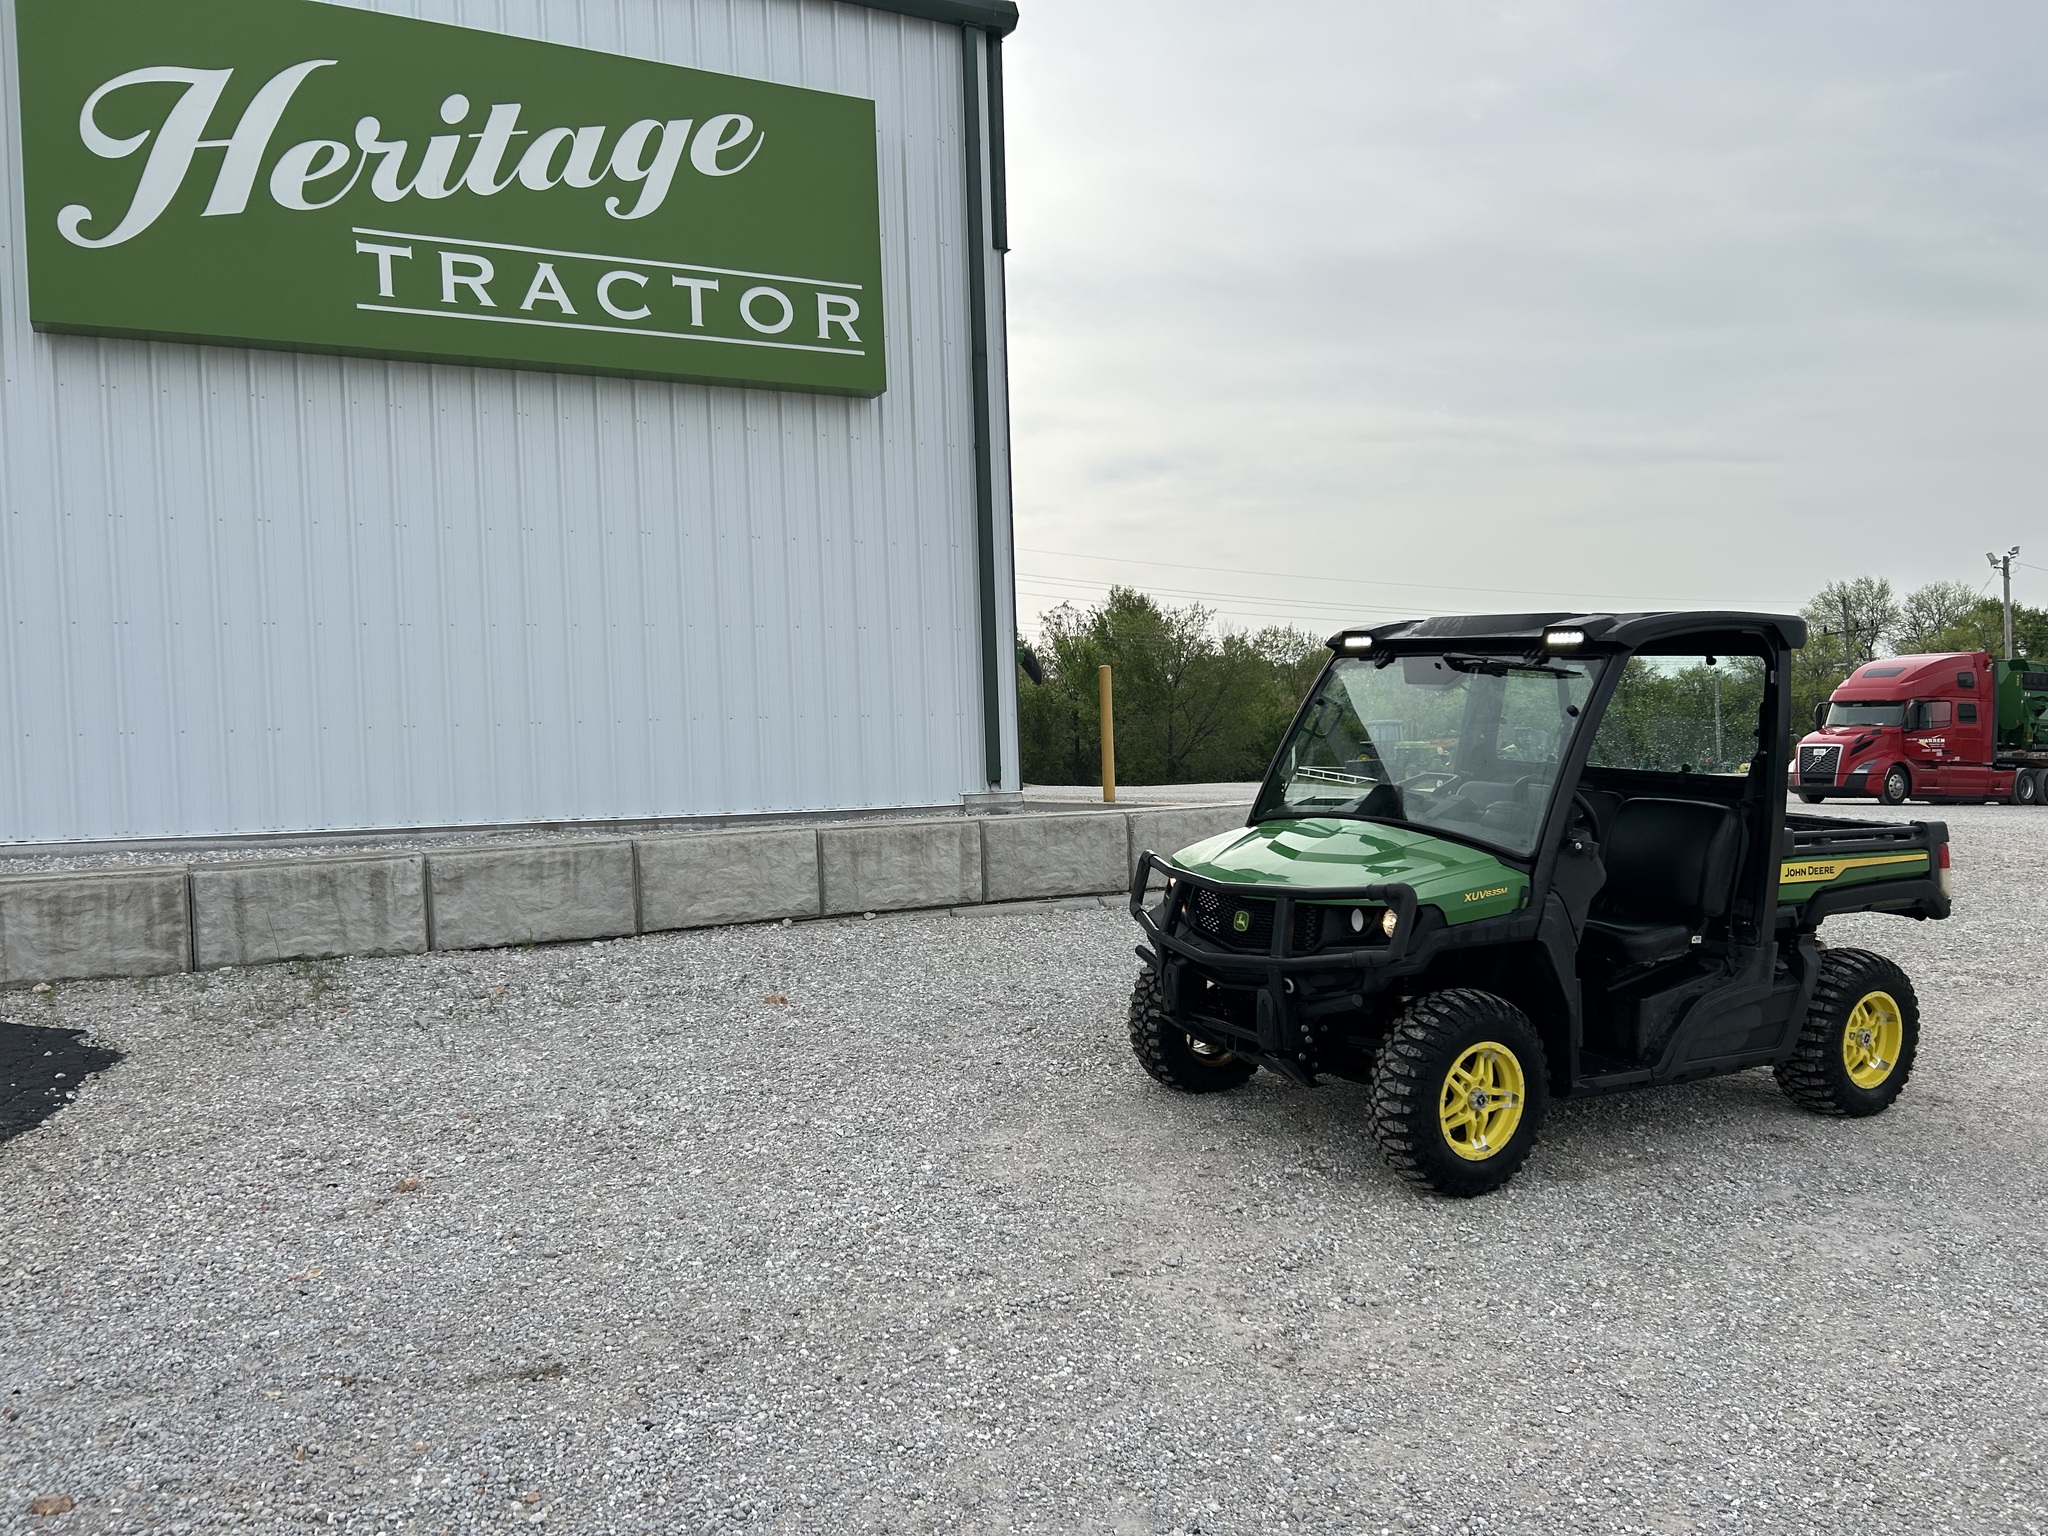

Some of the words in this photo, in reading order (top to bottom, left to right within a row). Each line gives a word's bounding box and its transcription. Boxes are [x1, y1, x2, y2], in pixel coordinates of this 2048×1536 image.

[57, 60, 764, 249] Heritage
[356, 240, 863, 342] TRACTOR
[1785, 866, 1807, 878] JOHN
[1808, 866, 1835, 876] DEERE
